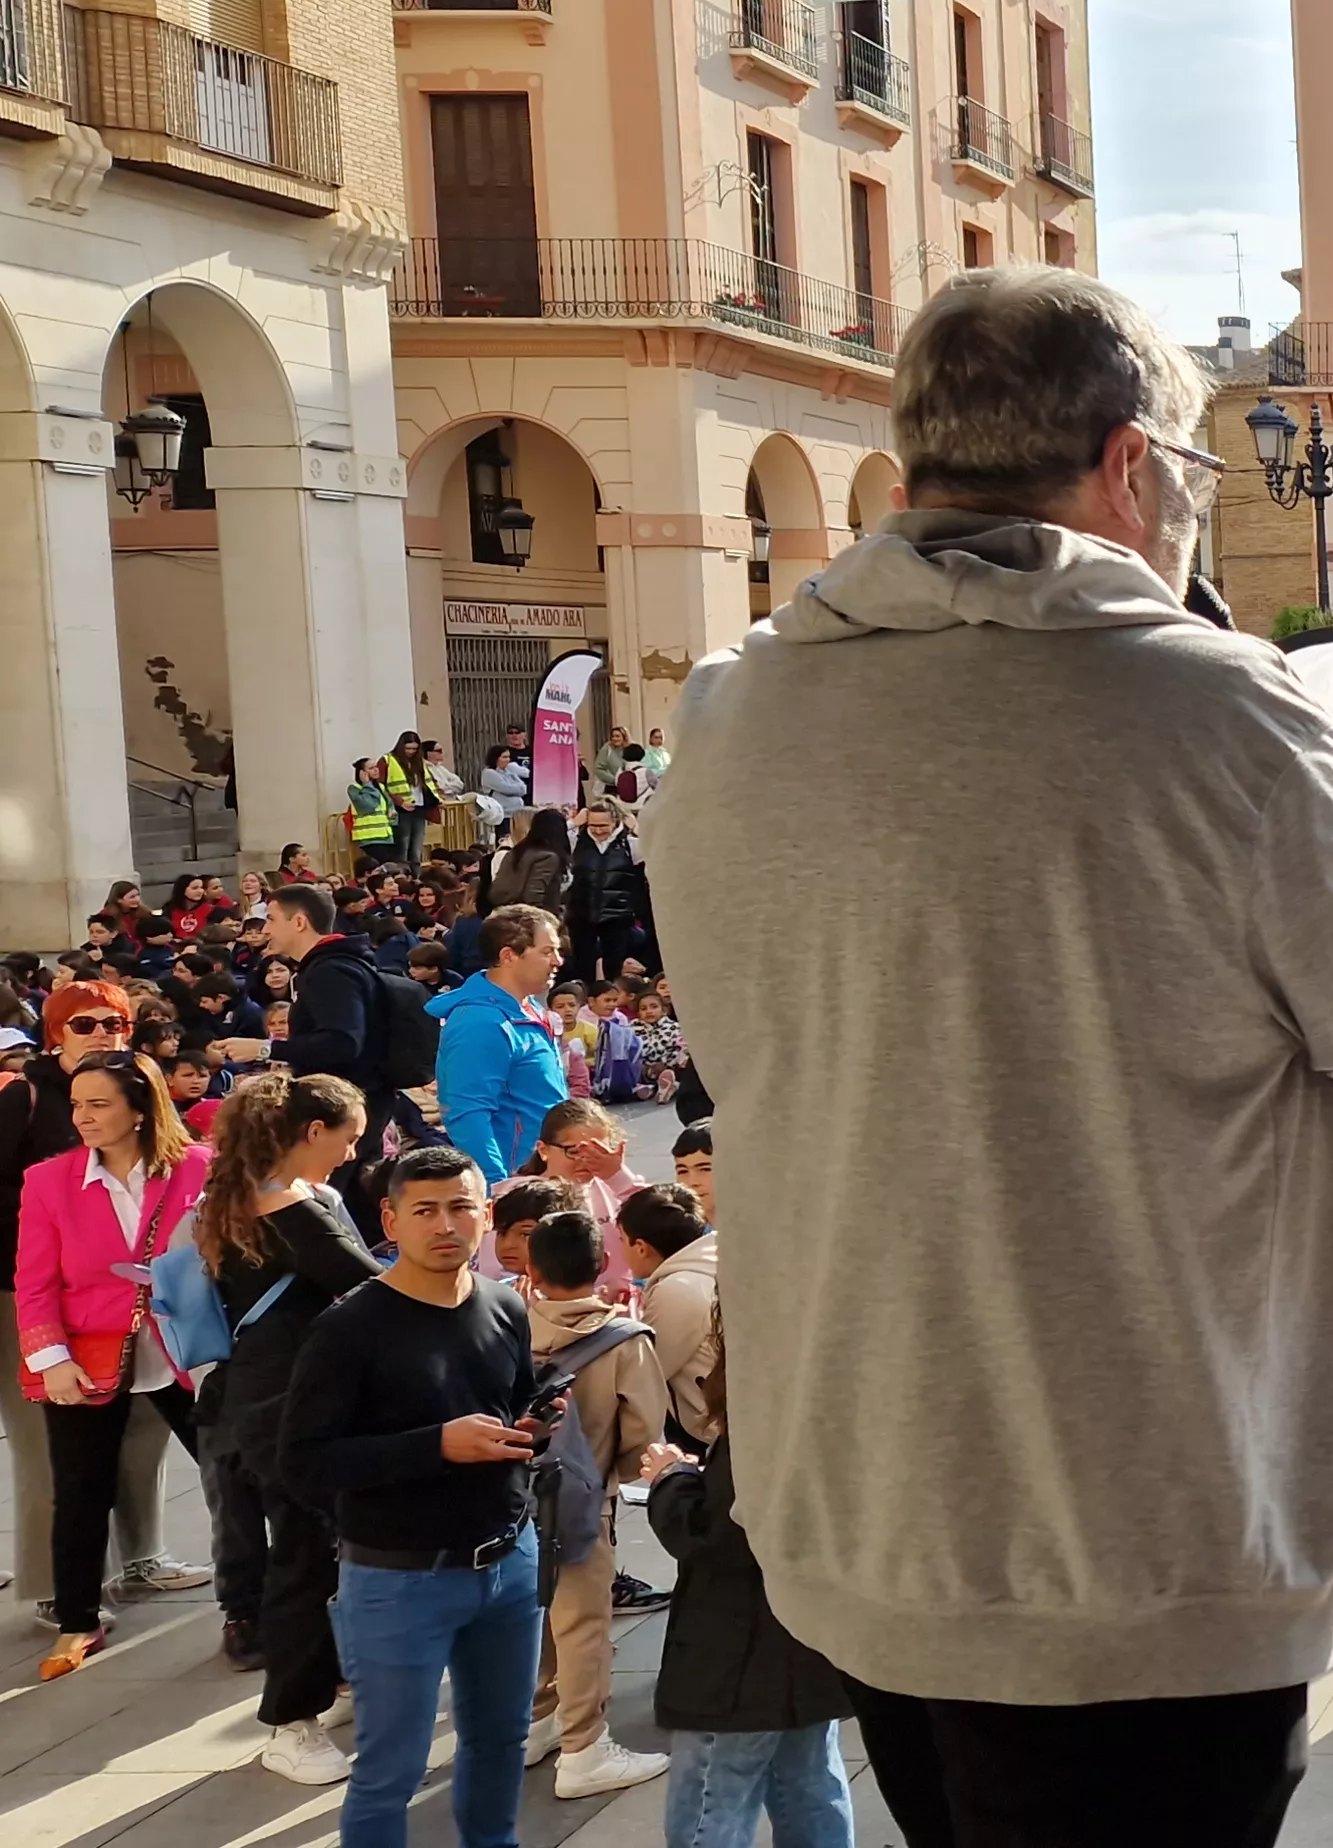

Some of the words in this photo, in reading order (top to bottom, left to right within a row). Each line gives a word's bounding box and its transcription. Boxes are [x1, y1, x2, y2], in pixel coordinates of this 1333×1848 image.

[447, 603, 509, 625] CHACINERIA
[526, 607, 561, 626] AMADO
[563, 608, 582, 627] ARA
